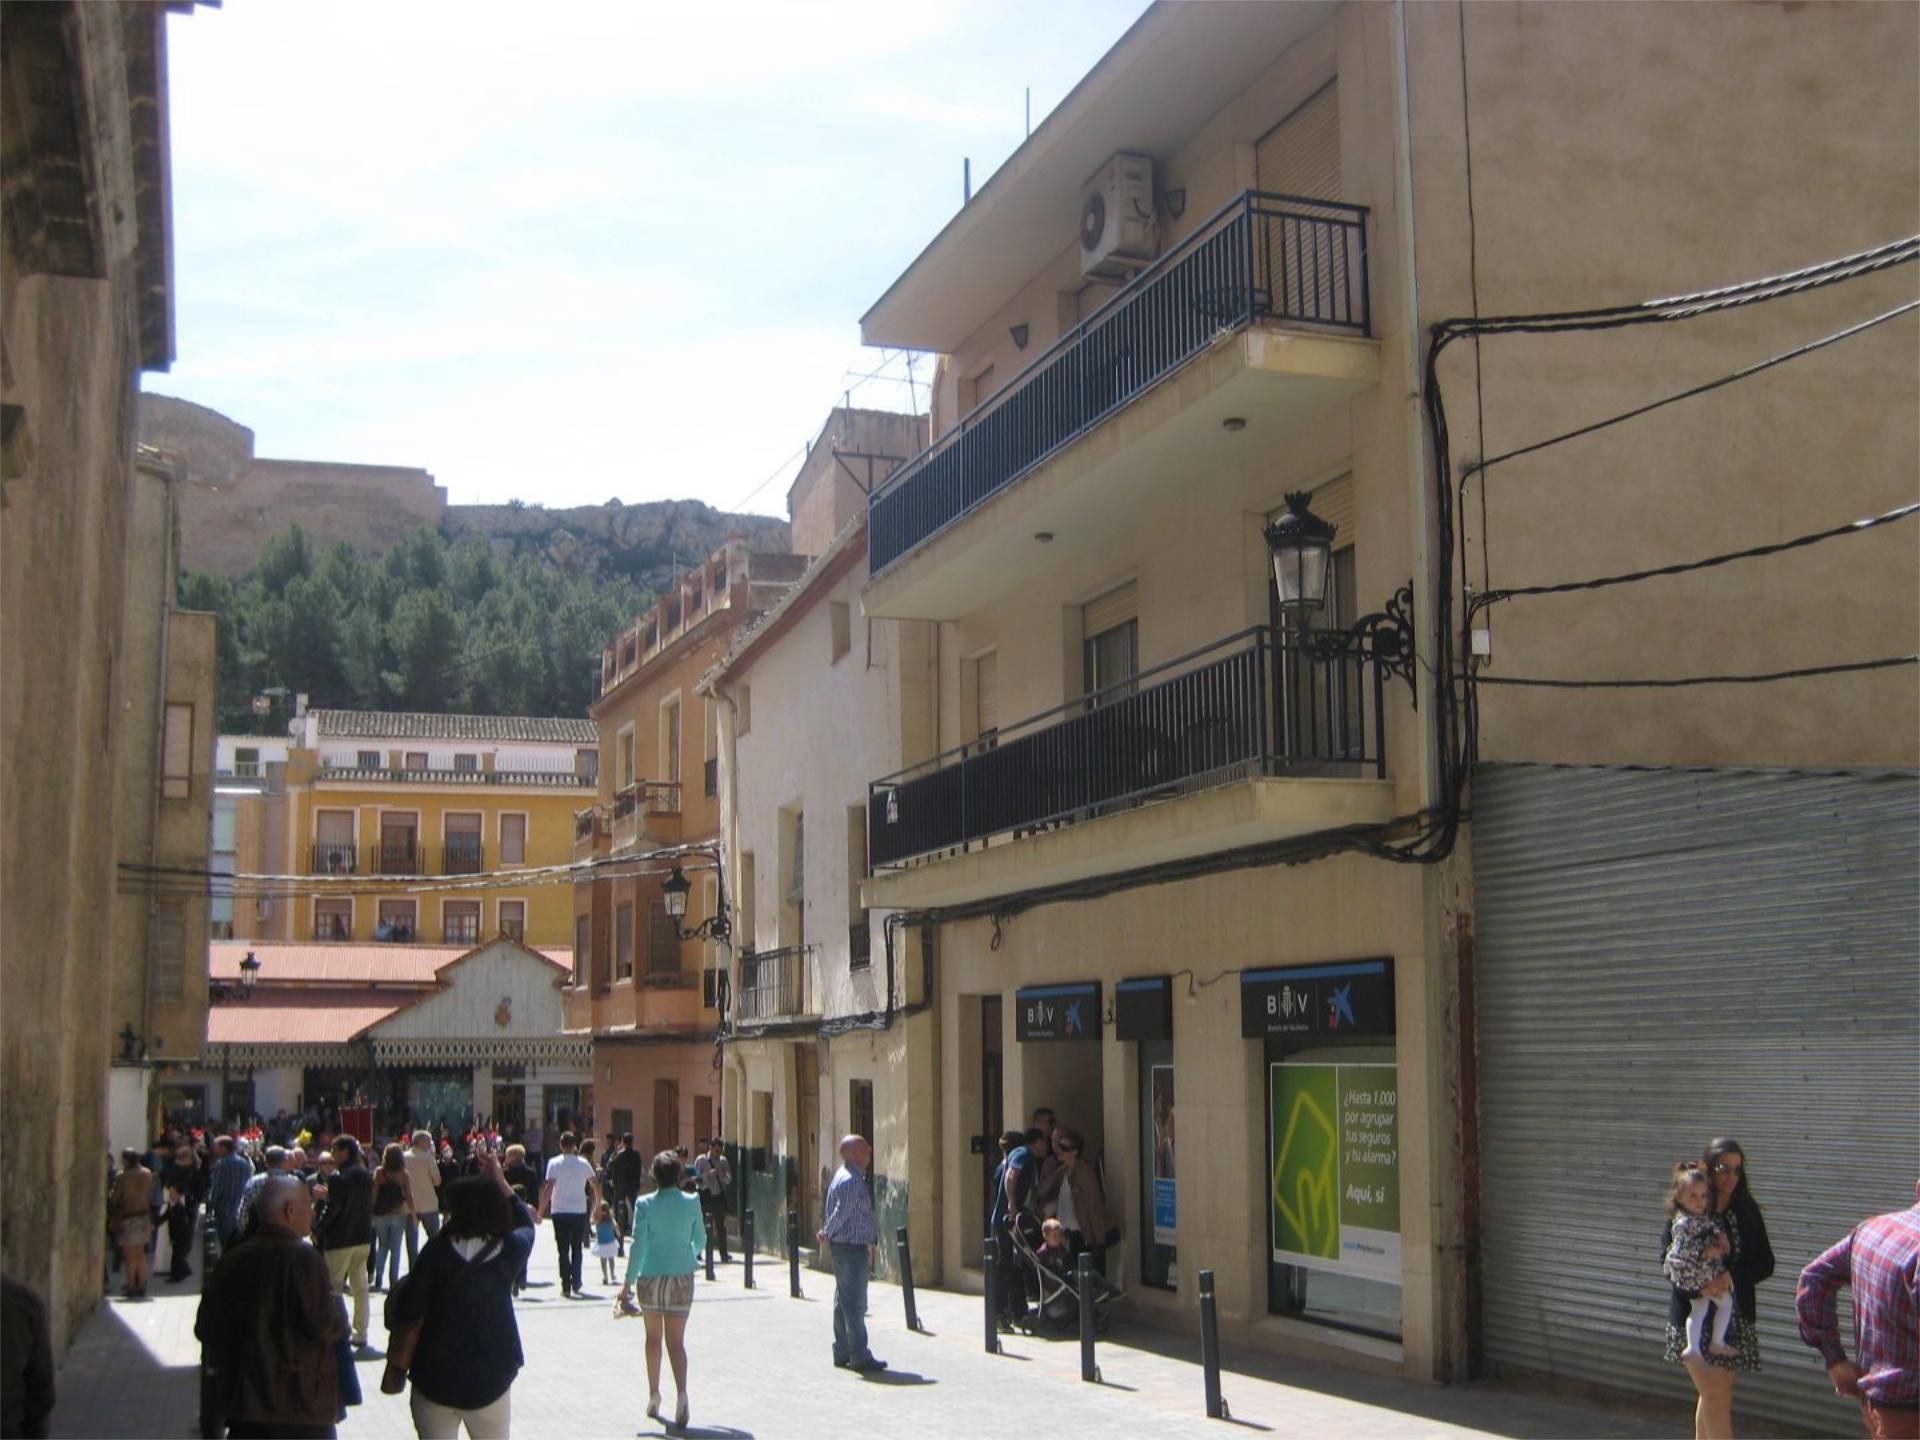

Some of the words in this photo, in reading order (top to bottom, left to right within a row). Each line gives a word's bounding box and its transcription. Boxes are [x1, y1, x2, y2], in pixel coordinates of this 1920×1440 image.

[1344, 1090, 1371, 1108] ¿Hasta
[1345, 1112, 1358, 1126] por
[1360, 1113, 1394, 1128] agrupar
[1358, 1131, 1391, 1147] seguros
[1345, 1151, 1350, 1165] y
[1352, 1149, 1361, 1162] tu
[1362, 1149, 1397, 1167] alarma?
